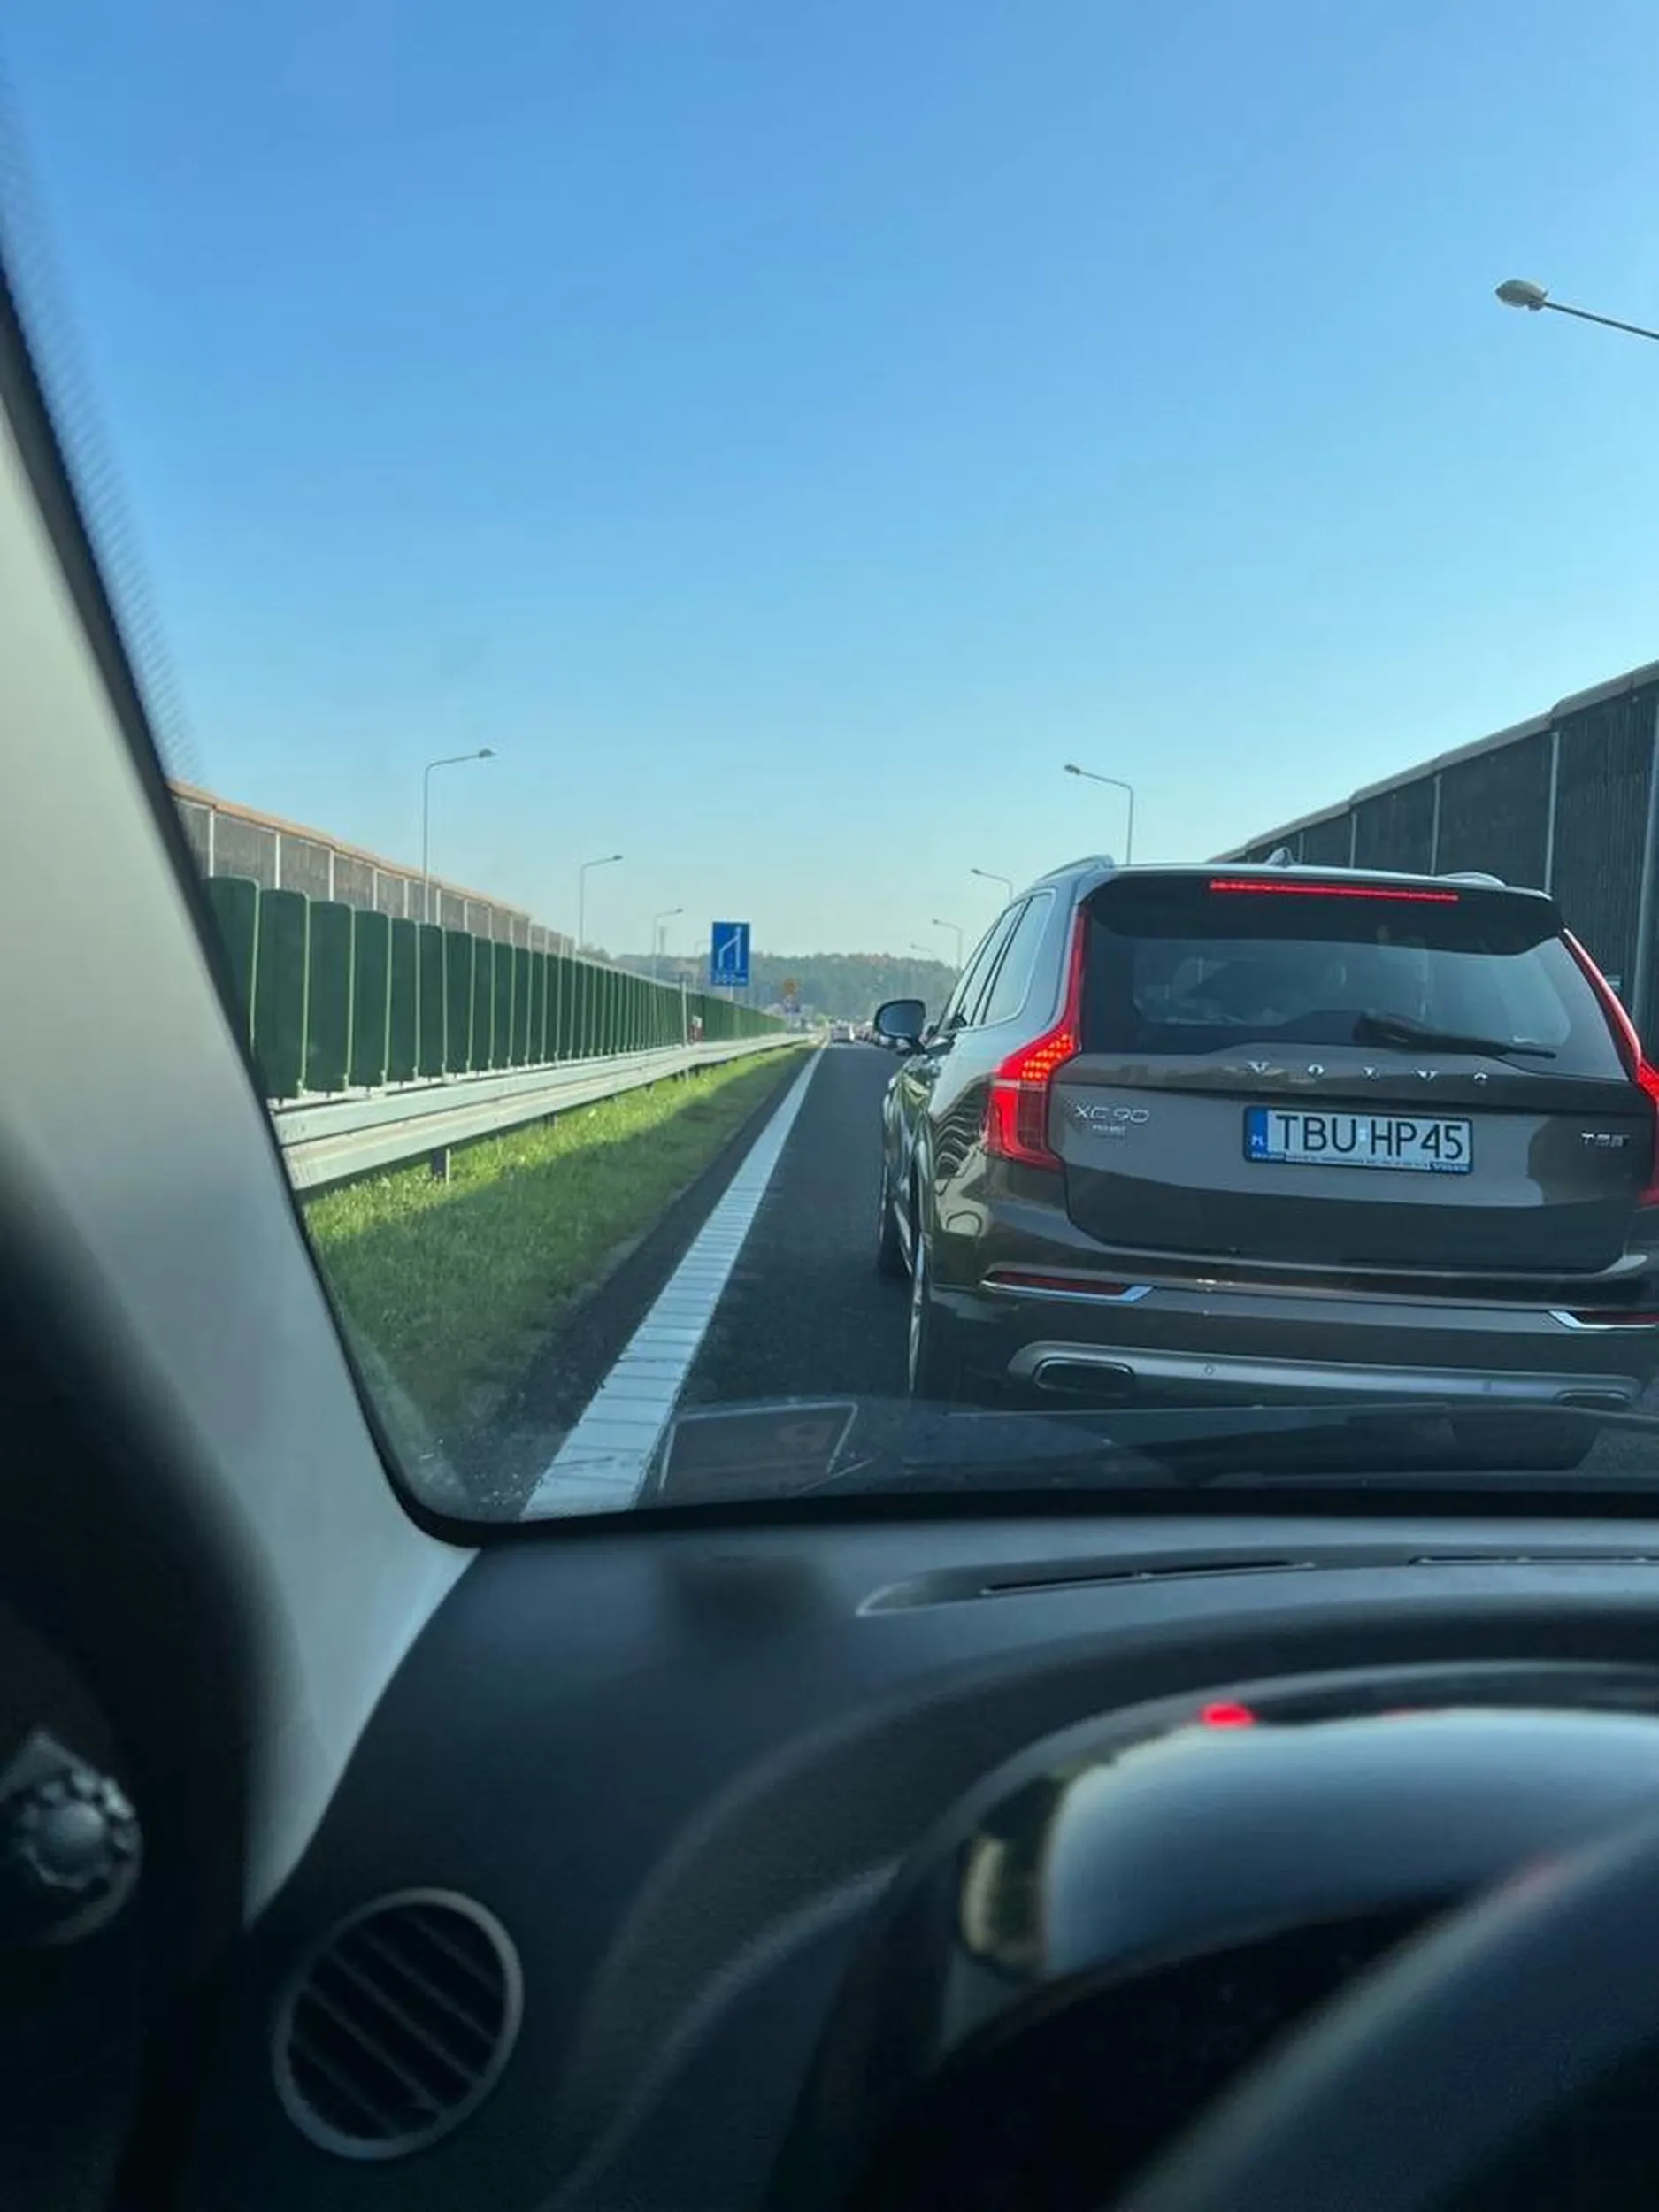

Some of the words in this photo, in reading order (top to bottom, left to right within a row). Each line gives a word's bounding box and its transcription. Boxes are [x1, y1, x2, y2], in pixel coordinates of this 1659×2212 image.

[1075, 1105, 1148, 1123] XC90
[1276, 1114, 1356, 1152] TBU
[1371, 1119, 1463, 1160] HP45
